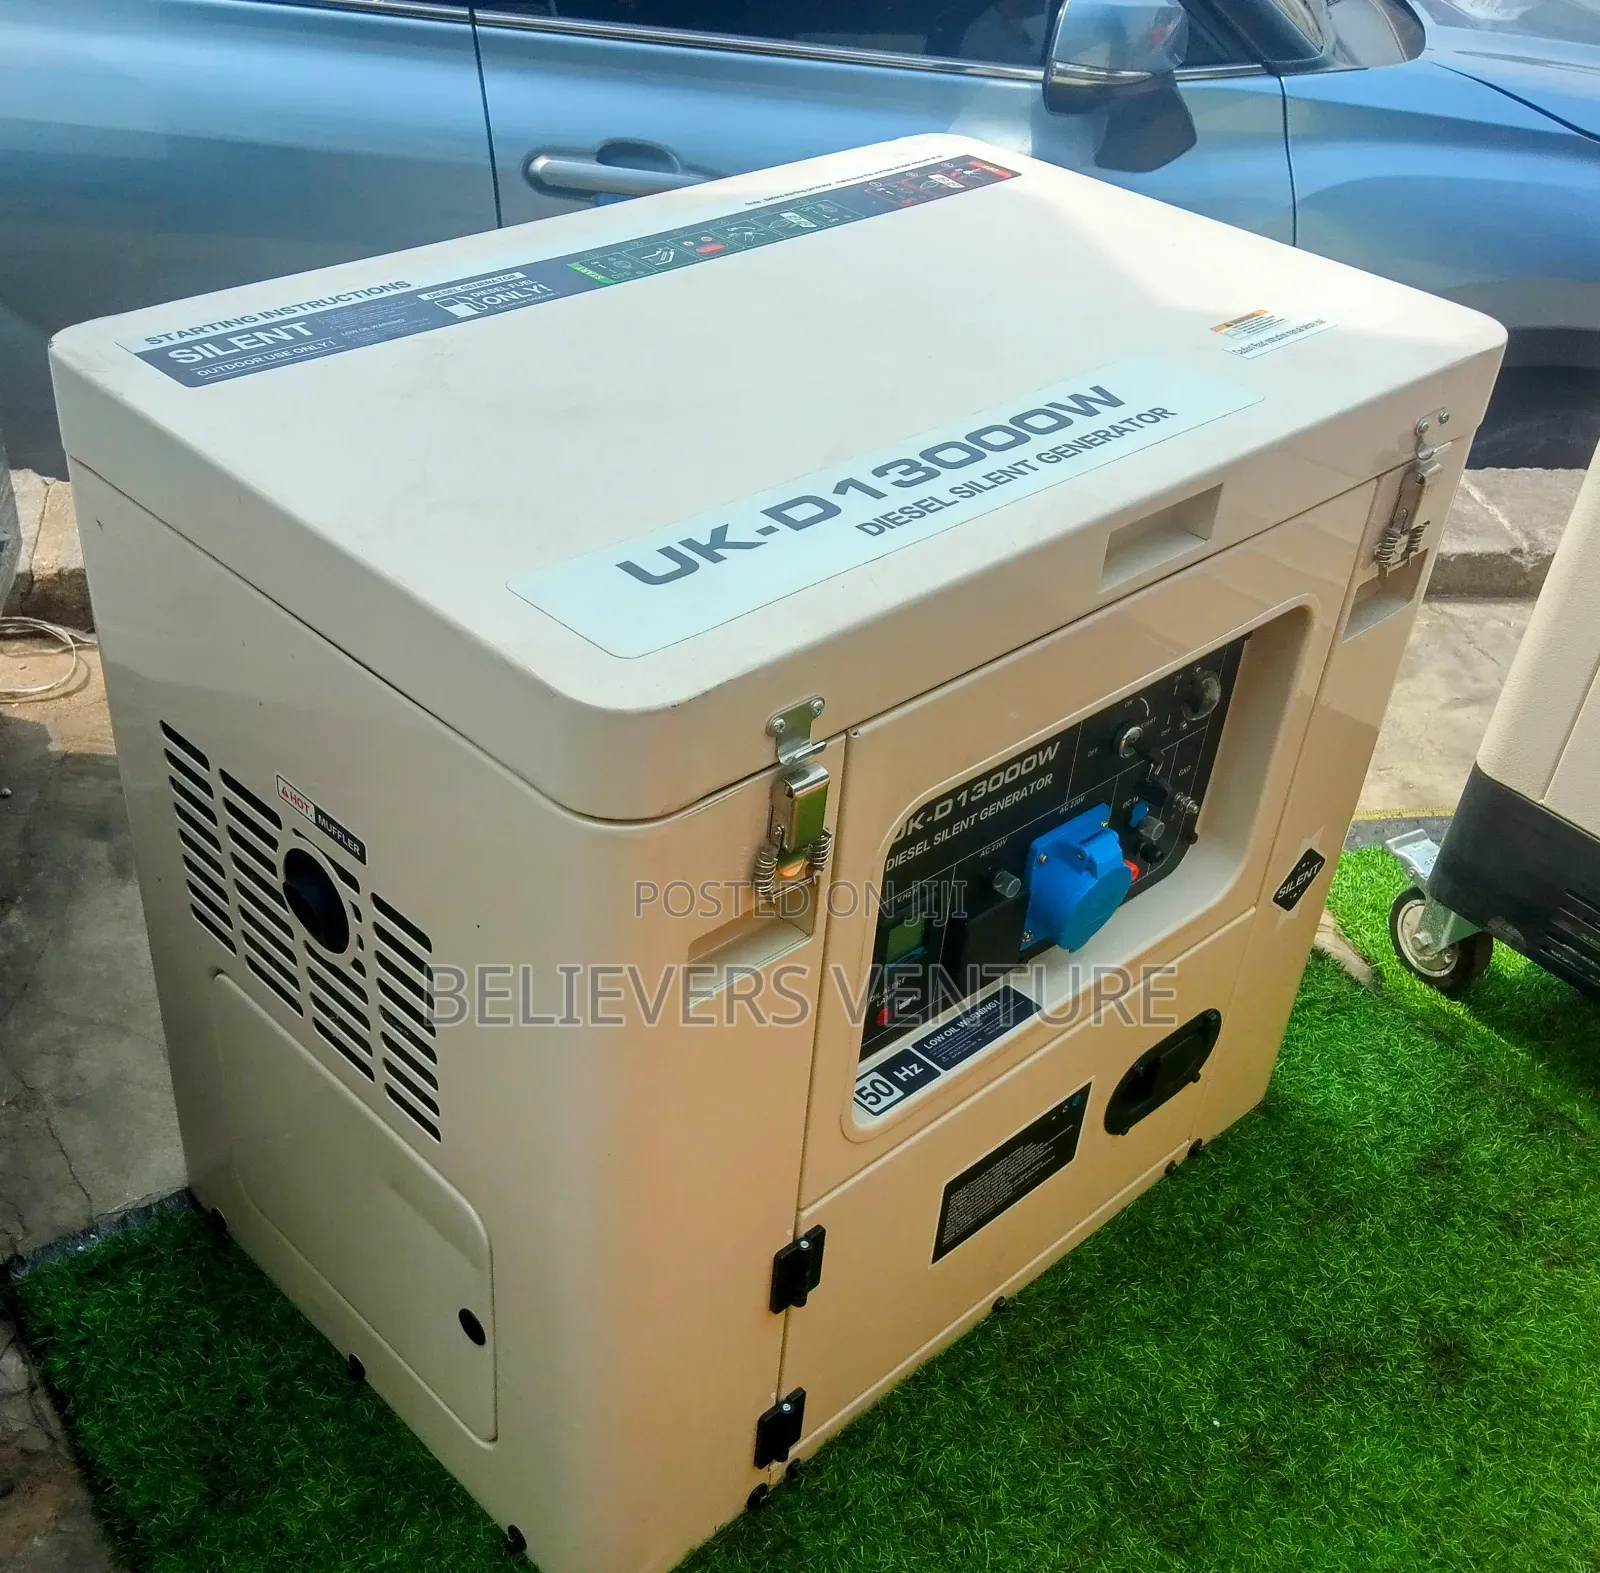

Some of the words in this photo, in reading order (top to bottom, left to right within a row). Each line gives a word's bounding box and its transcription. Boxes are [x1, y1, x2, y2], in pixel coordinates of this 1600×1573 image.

[461, 274, 518, 293] GENERATOR
[469, 285, 510, 298] DIESEL
[509, 279, 538, 290] FUEL
[482, 283, 553, 305] ONLY!
[144, 314, 259, 345] STARTING
[257, 280, 412, 320] INSTRUCTIONS
[168, 321, 314, 363] SILENT
[197, 356, 265, 377] OUTDOOR
[264, 350, 292, 361] USE
[615, 385, 1125, 585] UK-D13000W
[855, 495, 959, 537] DIESEL
[948, 459, 1039, 499] SILENT
[1035, 407, 1178, 464] GENERATOR
[1178, 765, 1192, 776] GND
[1059, 804, 1070, 814] AC
[1069, 795, 1086, 808] 230V
[318, 815, 360, 855] MUFFLER
[886, 839, 931, 872] DIESEL
[933, 812, 978, 846] SILENT
[979, 773, 1053, 821] GENERATOR
[980, 847, 992, 858] AC
[1277, 861, 1321, 899] SILENT
[923, 1034, 945, 1050] LOW
[944, 1026, 960, 1038] OIL
[855, 1078, 895, 1106] 50
[893, 1060, 924, 1082] Hz
